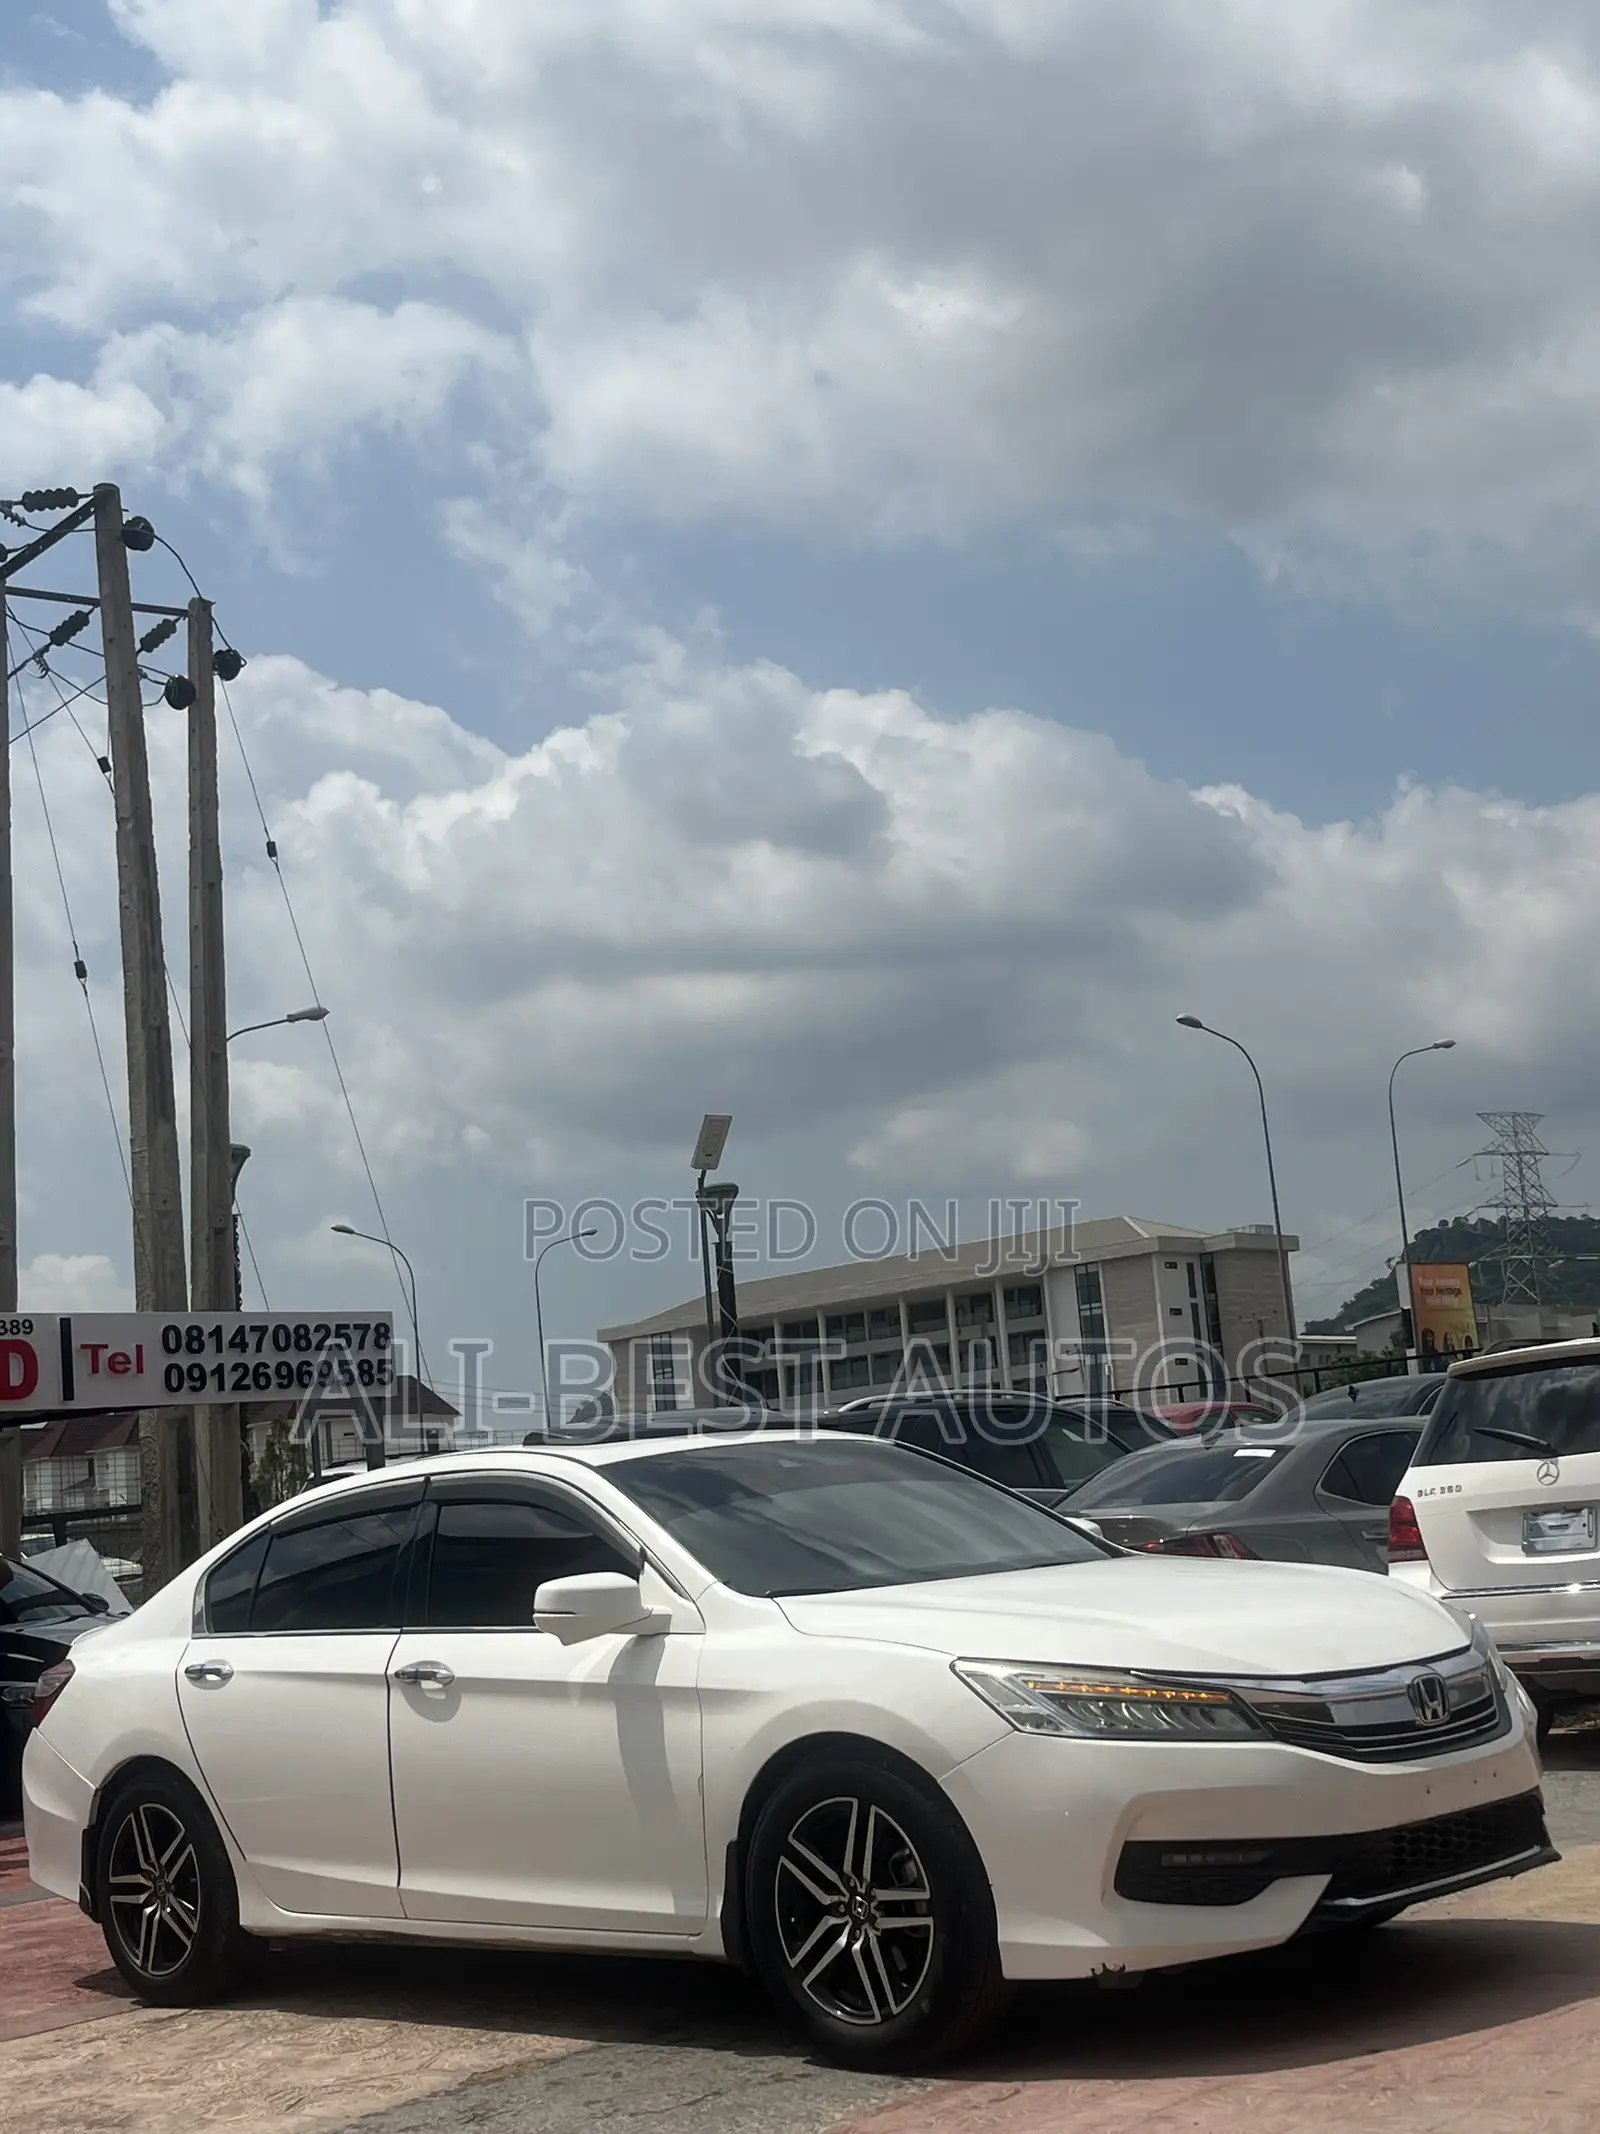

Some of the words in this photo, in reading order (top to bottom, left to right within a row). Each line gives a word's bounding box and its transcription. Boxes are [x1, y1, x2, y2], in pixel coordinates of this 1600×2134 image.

[80, 1343, 144, 1375] Tel
[161, 1322, 391, 1354] 08147082578
[164, 1358, 394, 1393] 09126969585
